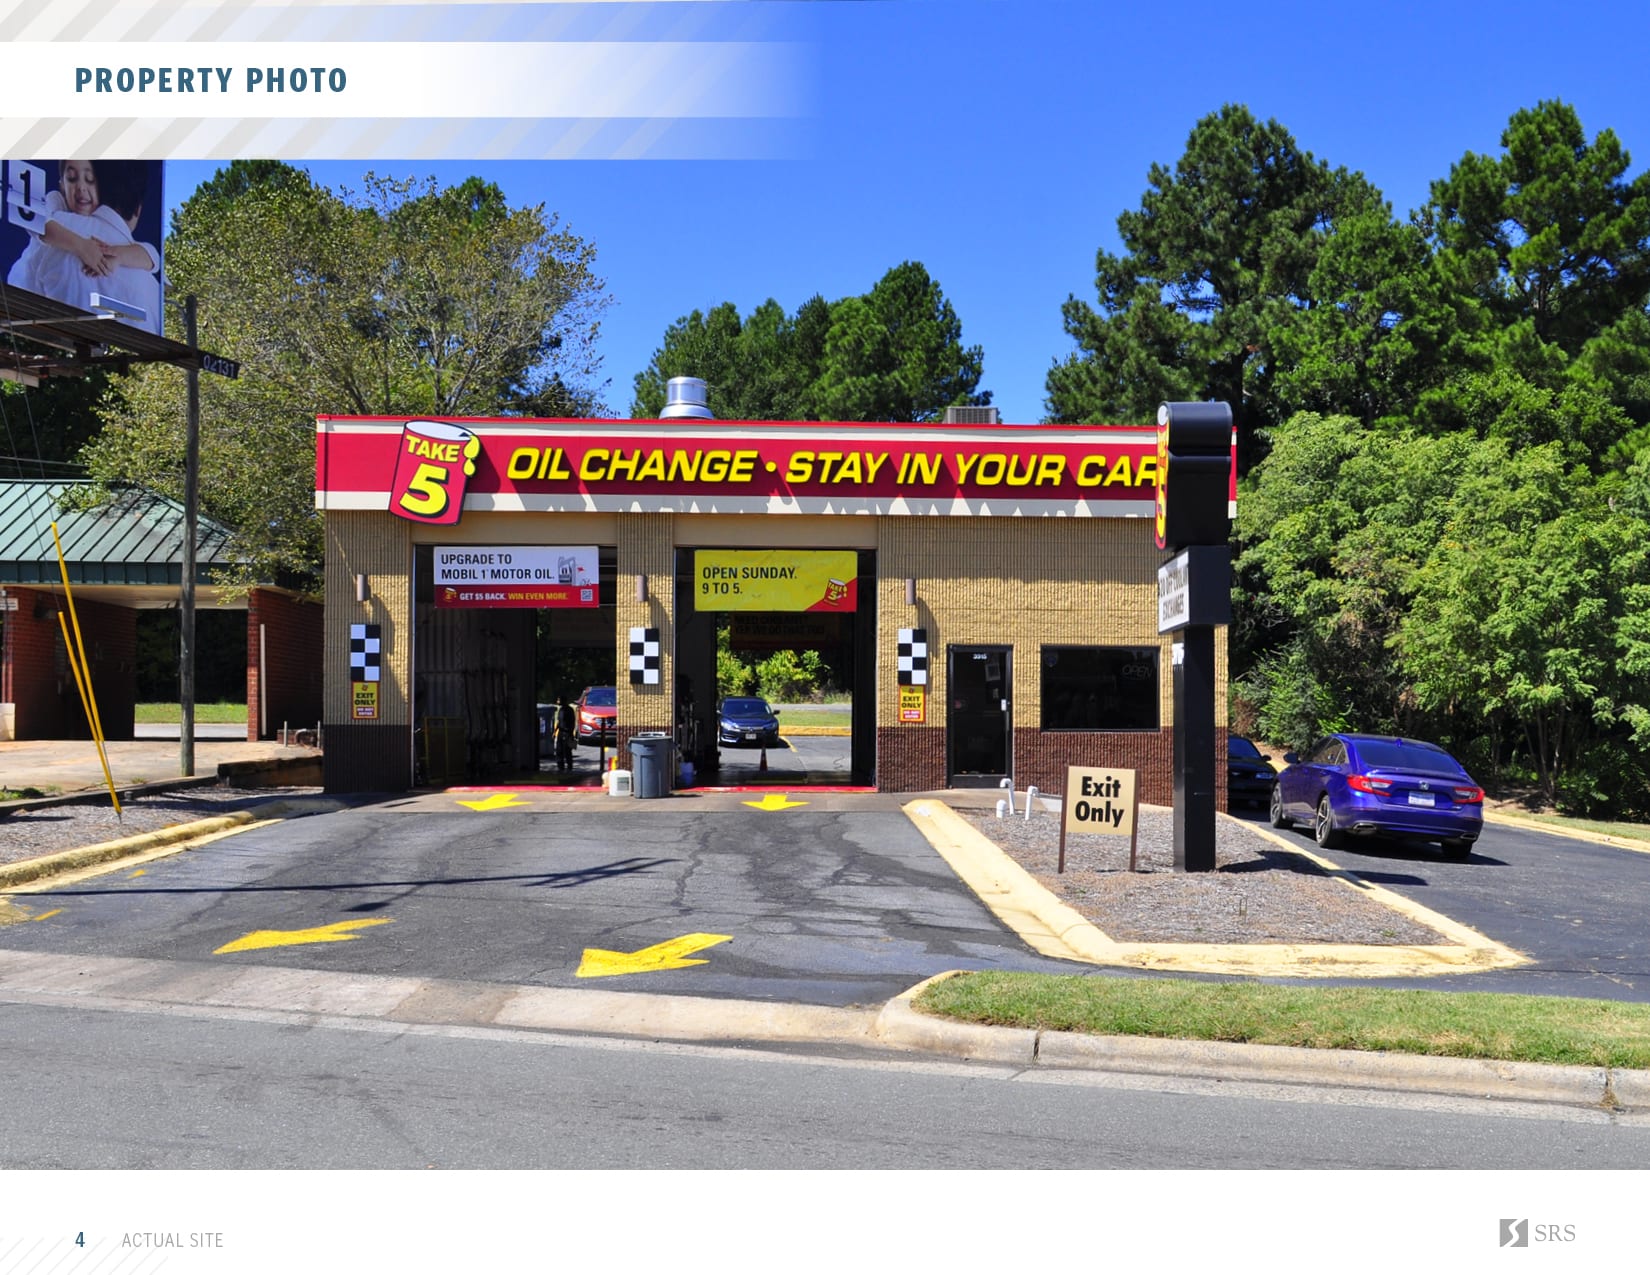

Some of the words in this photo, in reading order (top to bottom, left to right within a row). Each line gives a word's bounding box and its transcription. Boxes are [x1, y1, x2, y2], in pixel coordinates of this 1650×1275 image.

[406, 434, 460, 463] TAKE
[507, 447, 570, 480] OIL
[579, 448, 758, 482] CHANGE
[785, 451, 888, 484] STAY
[896, 453, 942, 485] IN
[955, 453, 1066, 486] YOUR
[1076, 455, 1157, 487] CAR
[399, 463, 449, 517] 5
[441, 554, 494, 565] UPGRADE
[498, 554, 512, 565] TO
[441, 568, 478, 579] MOBIL
[491, 568, 531, 579] MOTOR
[534, 568, 555, 579] OIL.
[702, 567, 738, 579] OPEN
[742, 567, 798, 579] SUNDAY.
[702, 583, 709, 594] 9
[712, 583, 729, 594] TO
[733, 583, 743, 594] 5.
[1122, 663, 1153, 680] OPEN
[1082, 776, 1121, 798] Exit
[1075, 800, 1125, 828] Only
